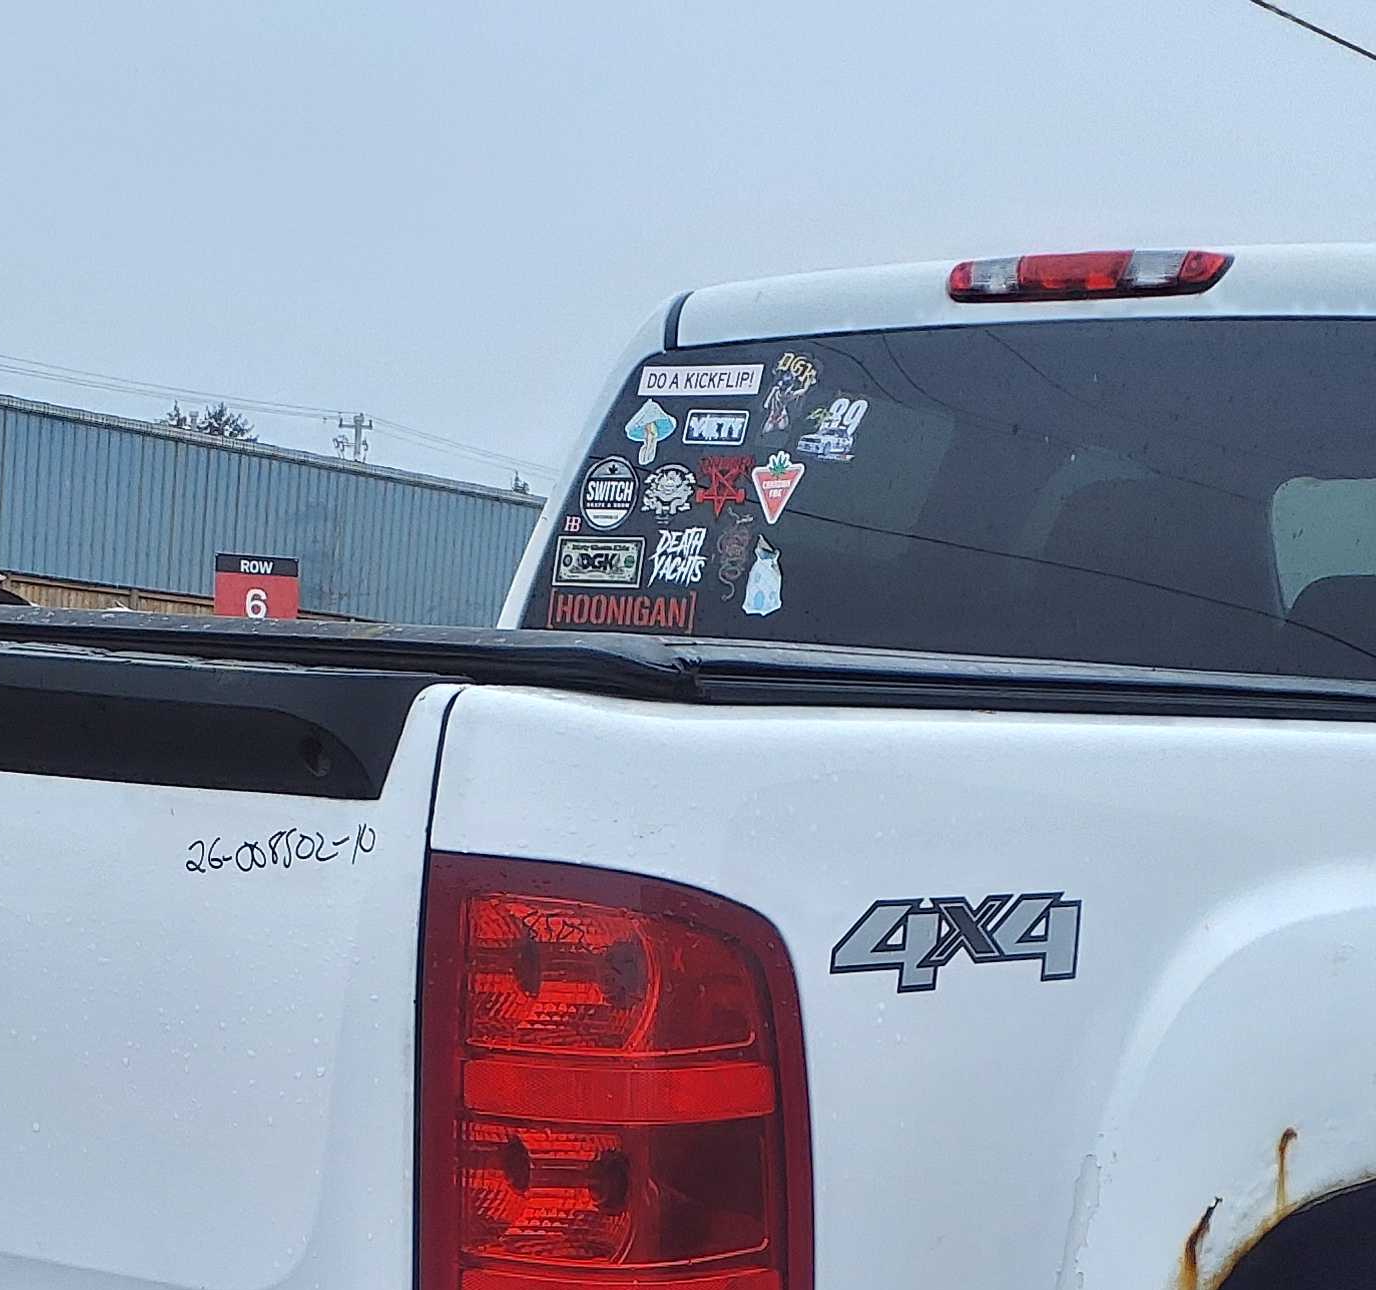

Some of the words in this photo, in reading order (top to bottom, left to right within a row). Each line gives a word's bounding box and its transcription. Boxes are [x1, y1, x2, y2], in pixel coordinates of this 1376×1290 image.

[647, 373, 667, 389] DO
[669, 373, 679, 388] A
[684, 371, 754, 389] KICKFLIP!
[587, 480, 634, 502] SWITCH
[657, 526, 707, 555] DEATH
[240, 560, 273, 574] ROW
[648, 554, 707, 588] YACHTS
[245, 588, 267, 619] 6
